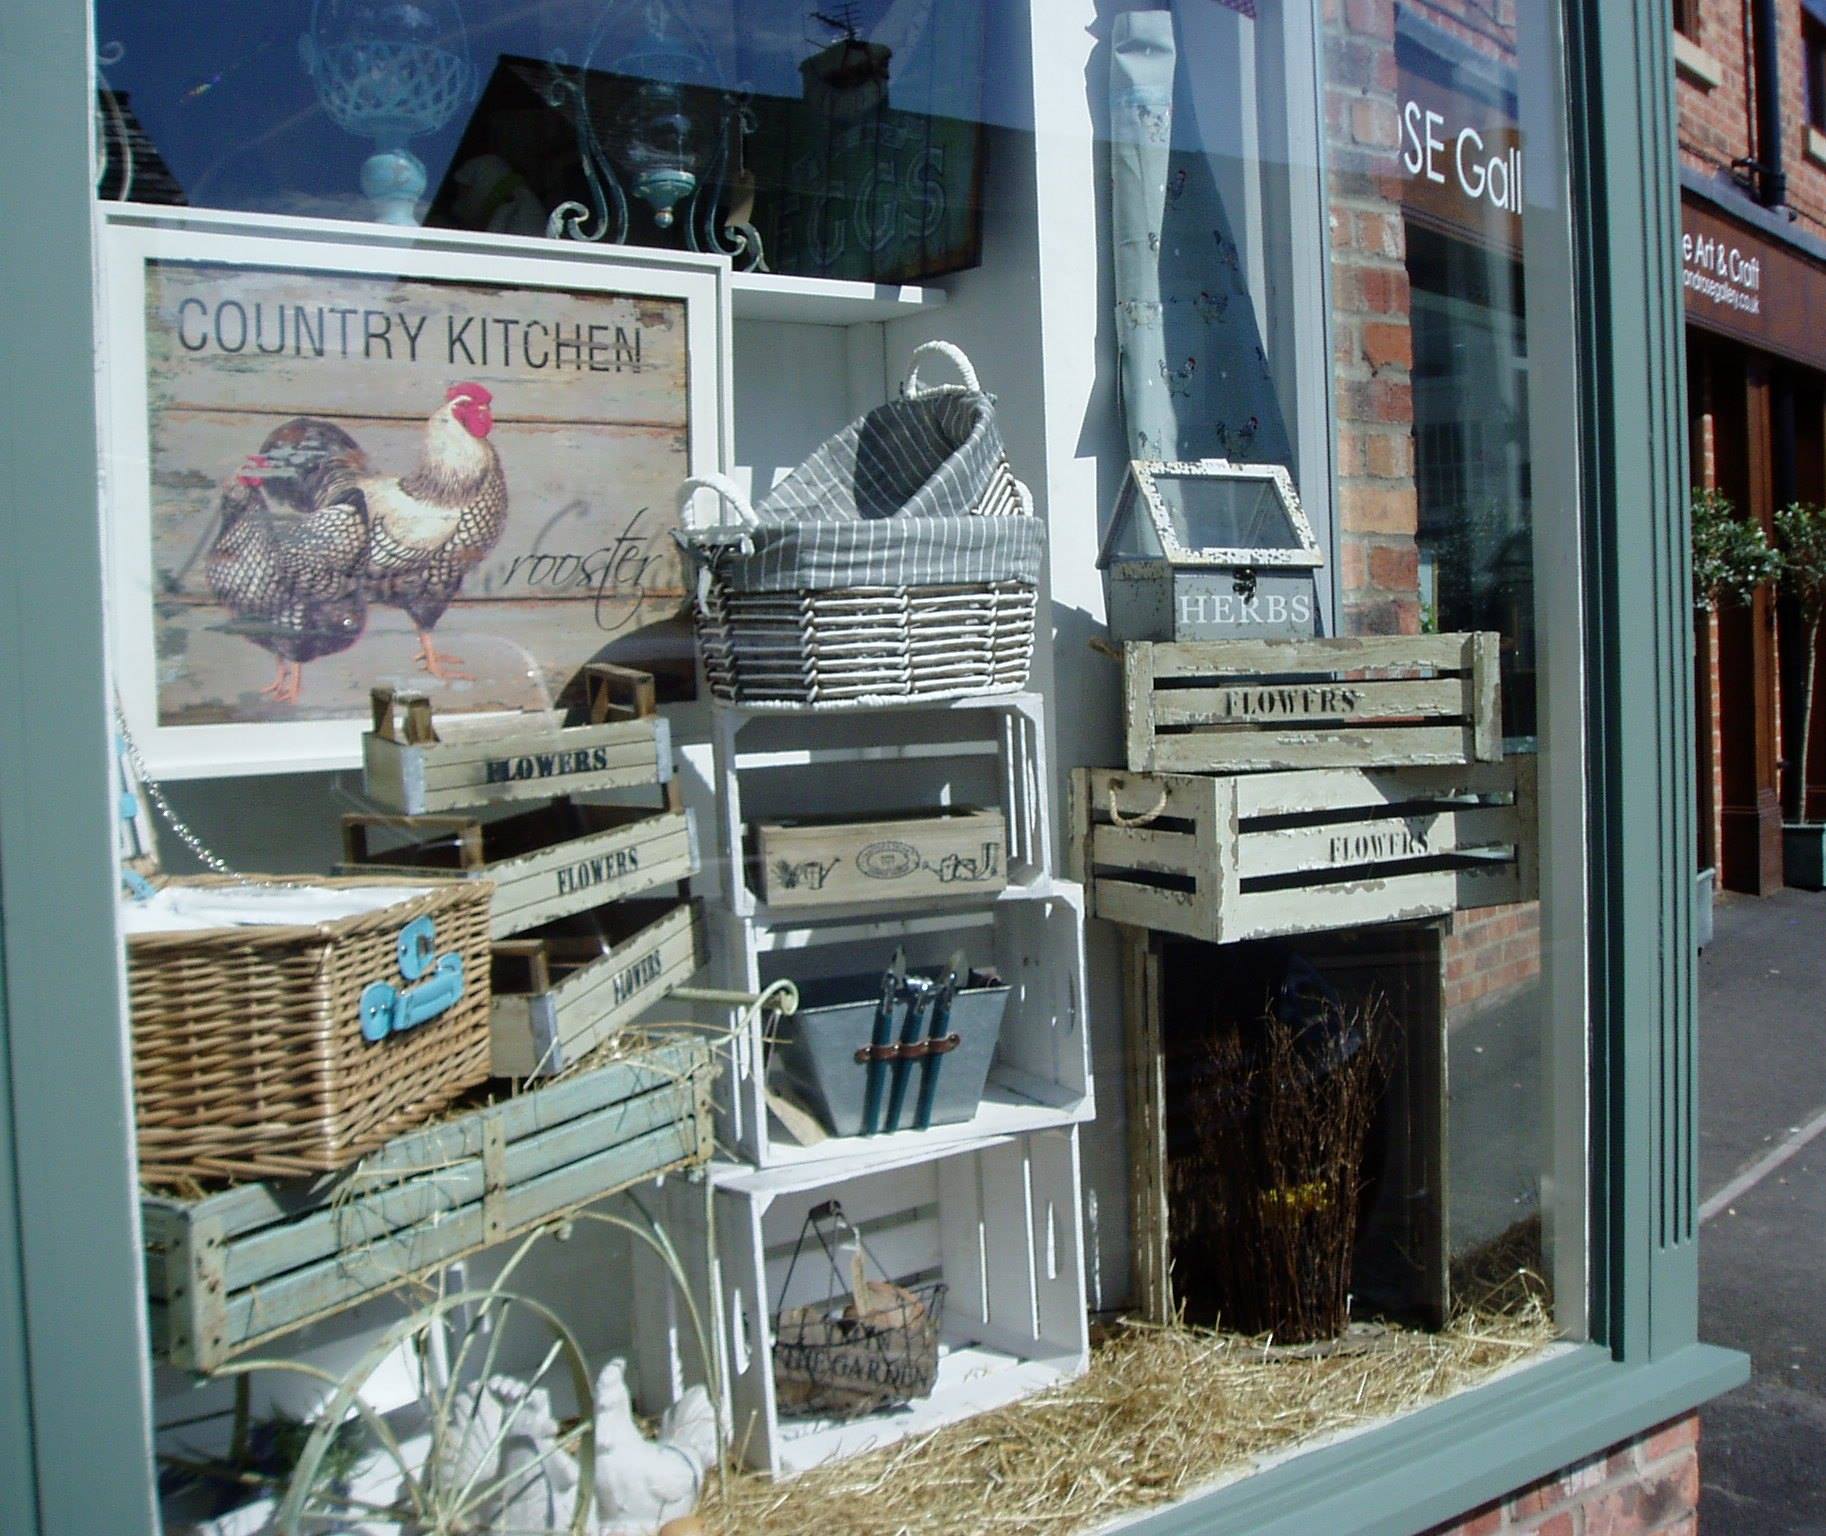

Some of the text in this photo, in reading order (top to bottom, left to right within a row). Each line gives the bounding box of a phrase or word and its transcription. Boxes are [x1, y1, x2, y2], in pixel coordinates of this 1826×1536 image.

[1397, 100, 1522, 215] SE Gall
[177, 297, 642, 374] COUNTRY KITCHEN
[503, 506, 663, 631] rooster
[1178, 594, 1311, 624] HERBS
[556, 846, 640, 897] FLOWERS
